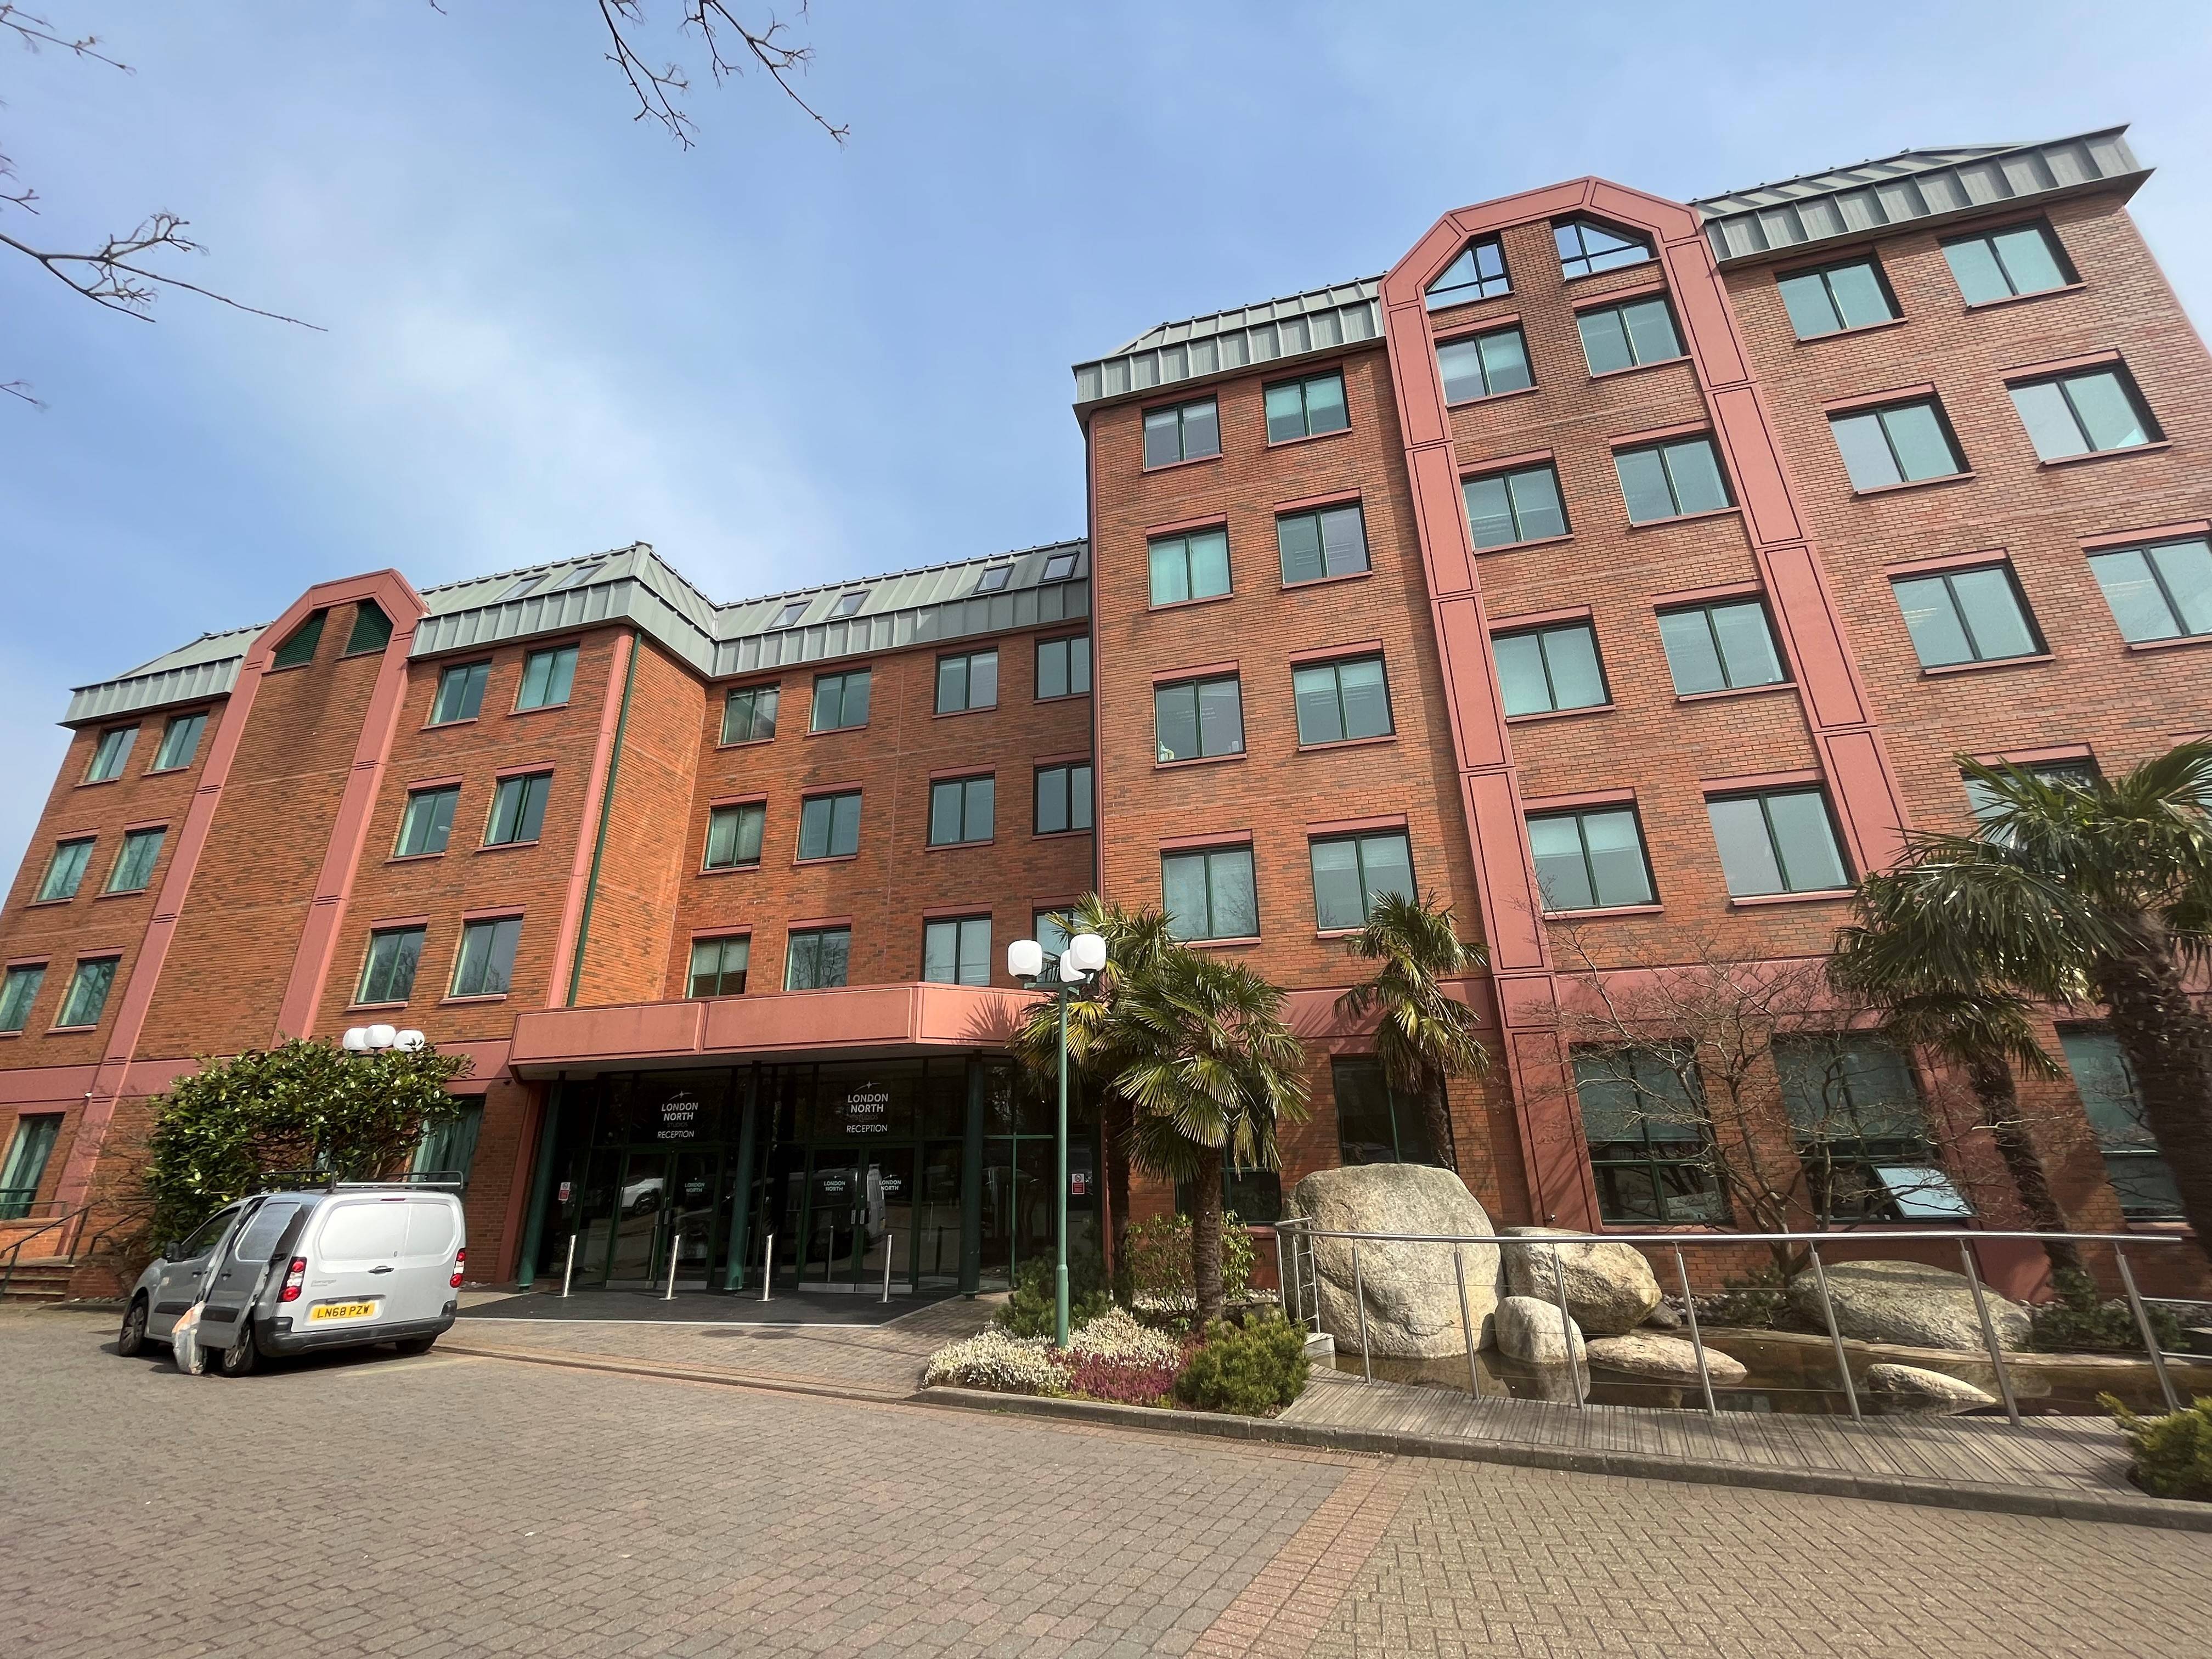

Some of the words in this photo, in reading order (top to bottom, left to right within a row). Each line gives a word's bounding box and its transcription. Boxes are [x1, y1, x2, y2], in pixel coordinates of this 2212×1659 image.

[847, 1093, 889, 1103] LONDON
[661, 1102, 698, 1111] LONDON
[850, 1104, 884, 1113] NORTH
[663, 1111, 693, 1121] NORTH
[846, 1124, 888, 1133] RECEPTION
[657, 1130, 695, 1138] RECEPTION
[317, 1307, 346, 1318] LN68
[348, 1305, 370, 1316] PZW
